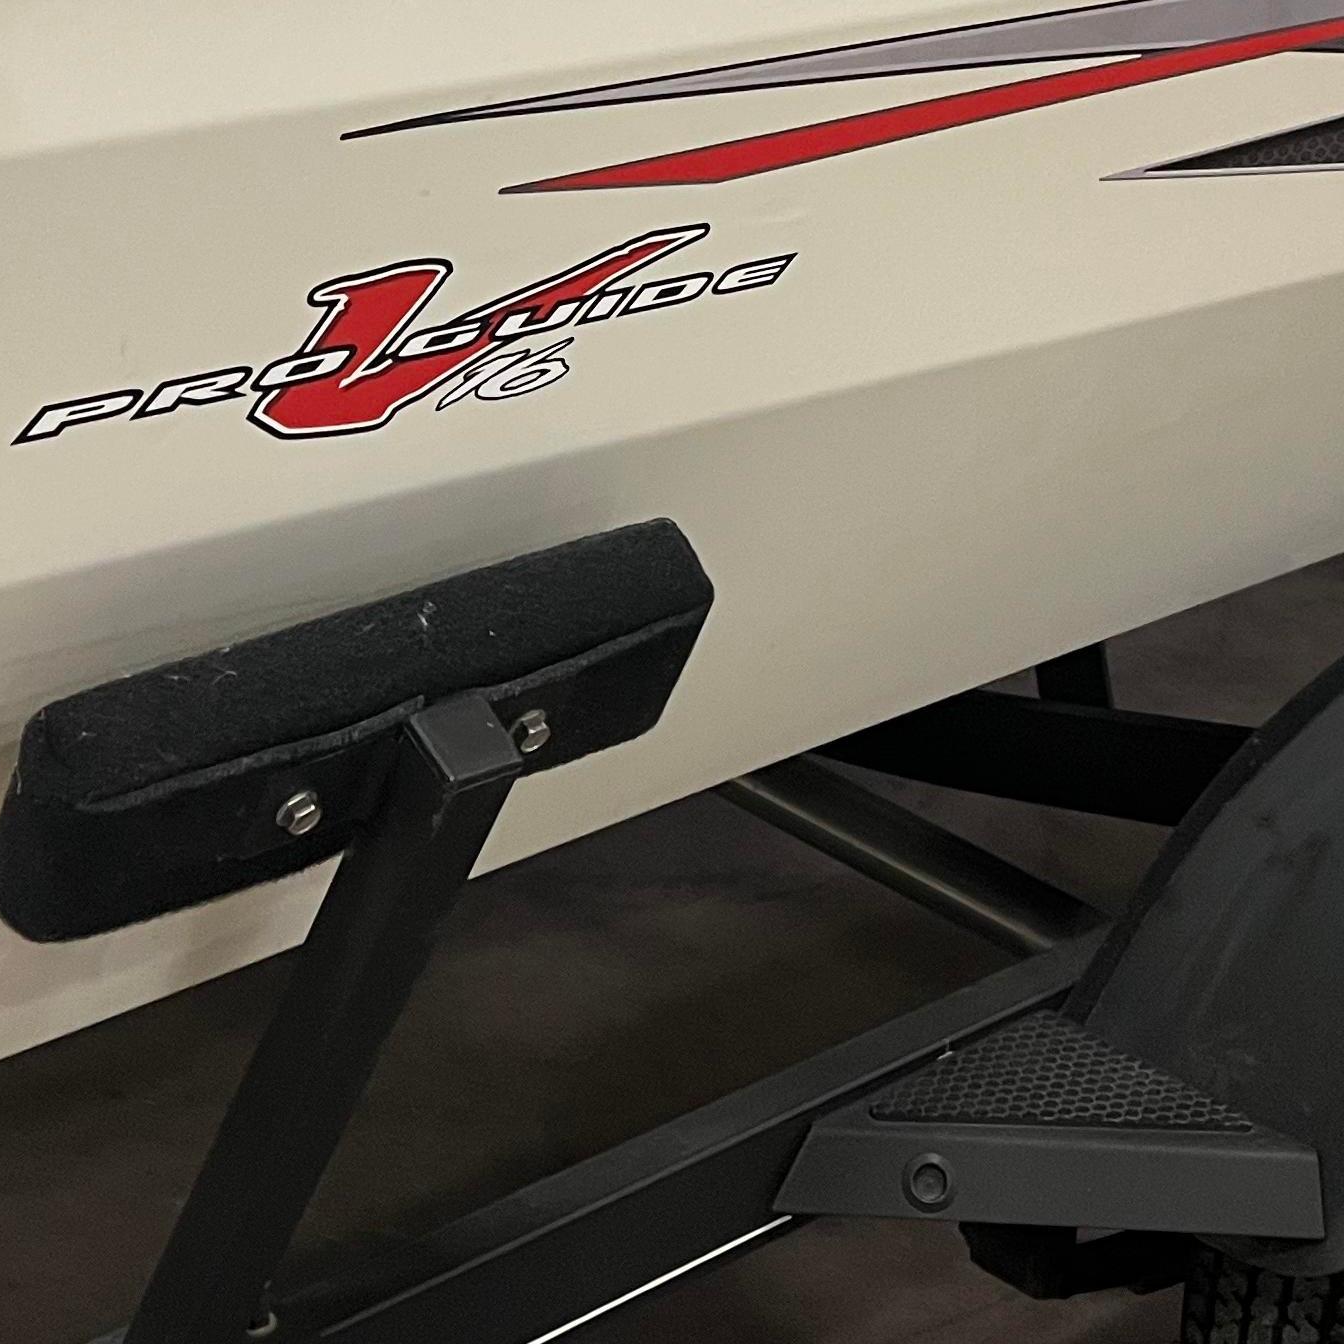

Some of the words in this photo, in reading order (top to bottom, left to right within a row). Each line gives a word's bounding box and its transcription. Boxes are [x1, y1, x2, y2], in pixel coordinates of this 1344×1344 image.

[11, 345, 359, 446] PRO
[389, 252, 799, 364] GUIDE
[435, 337, 575, 412] 16
